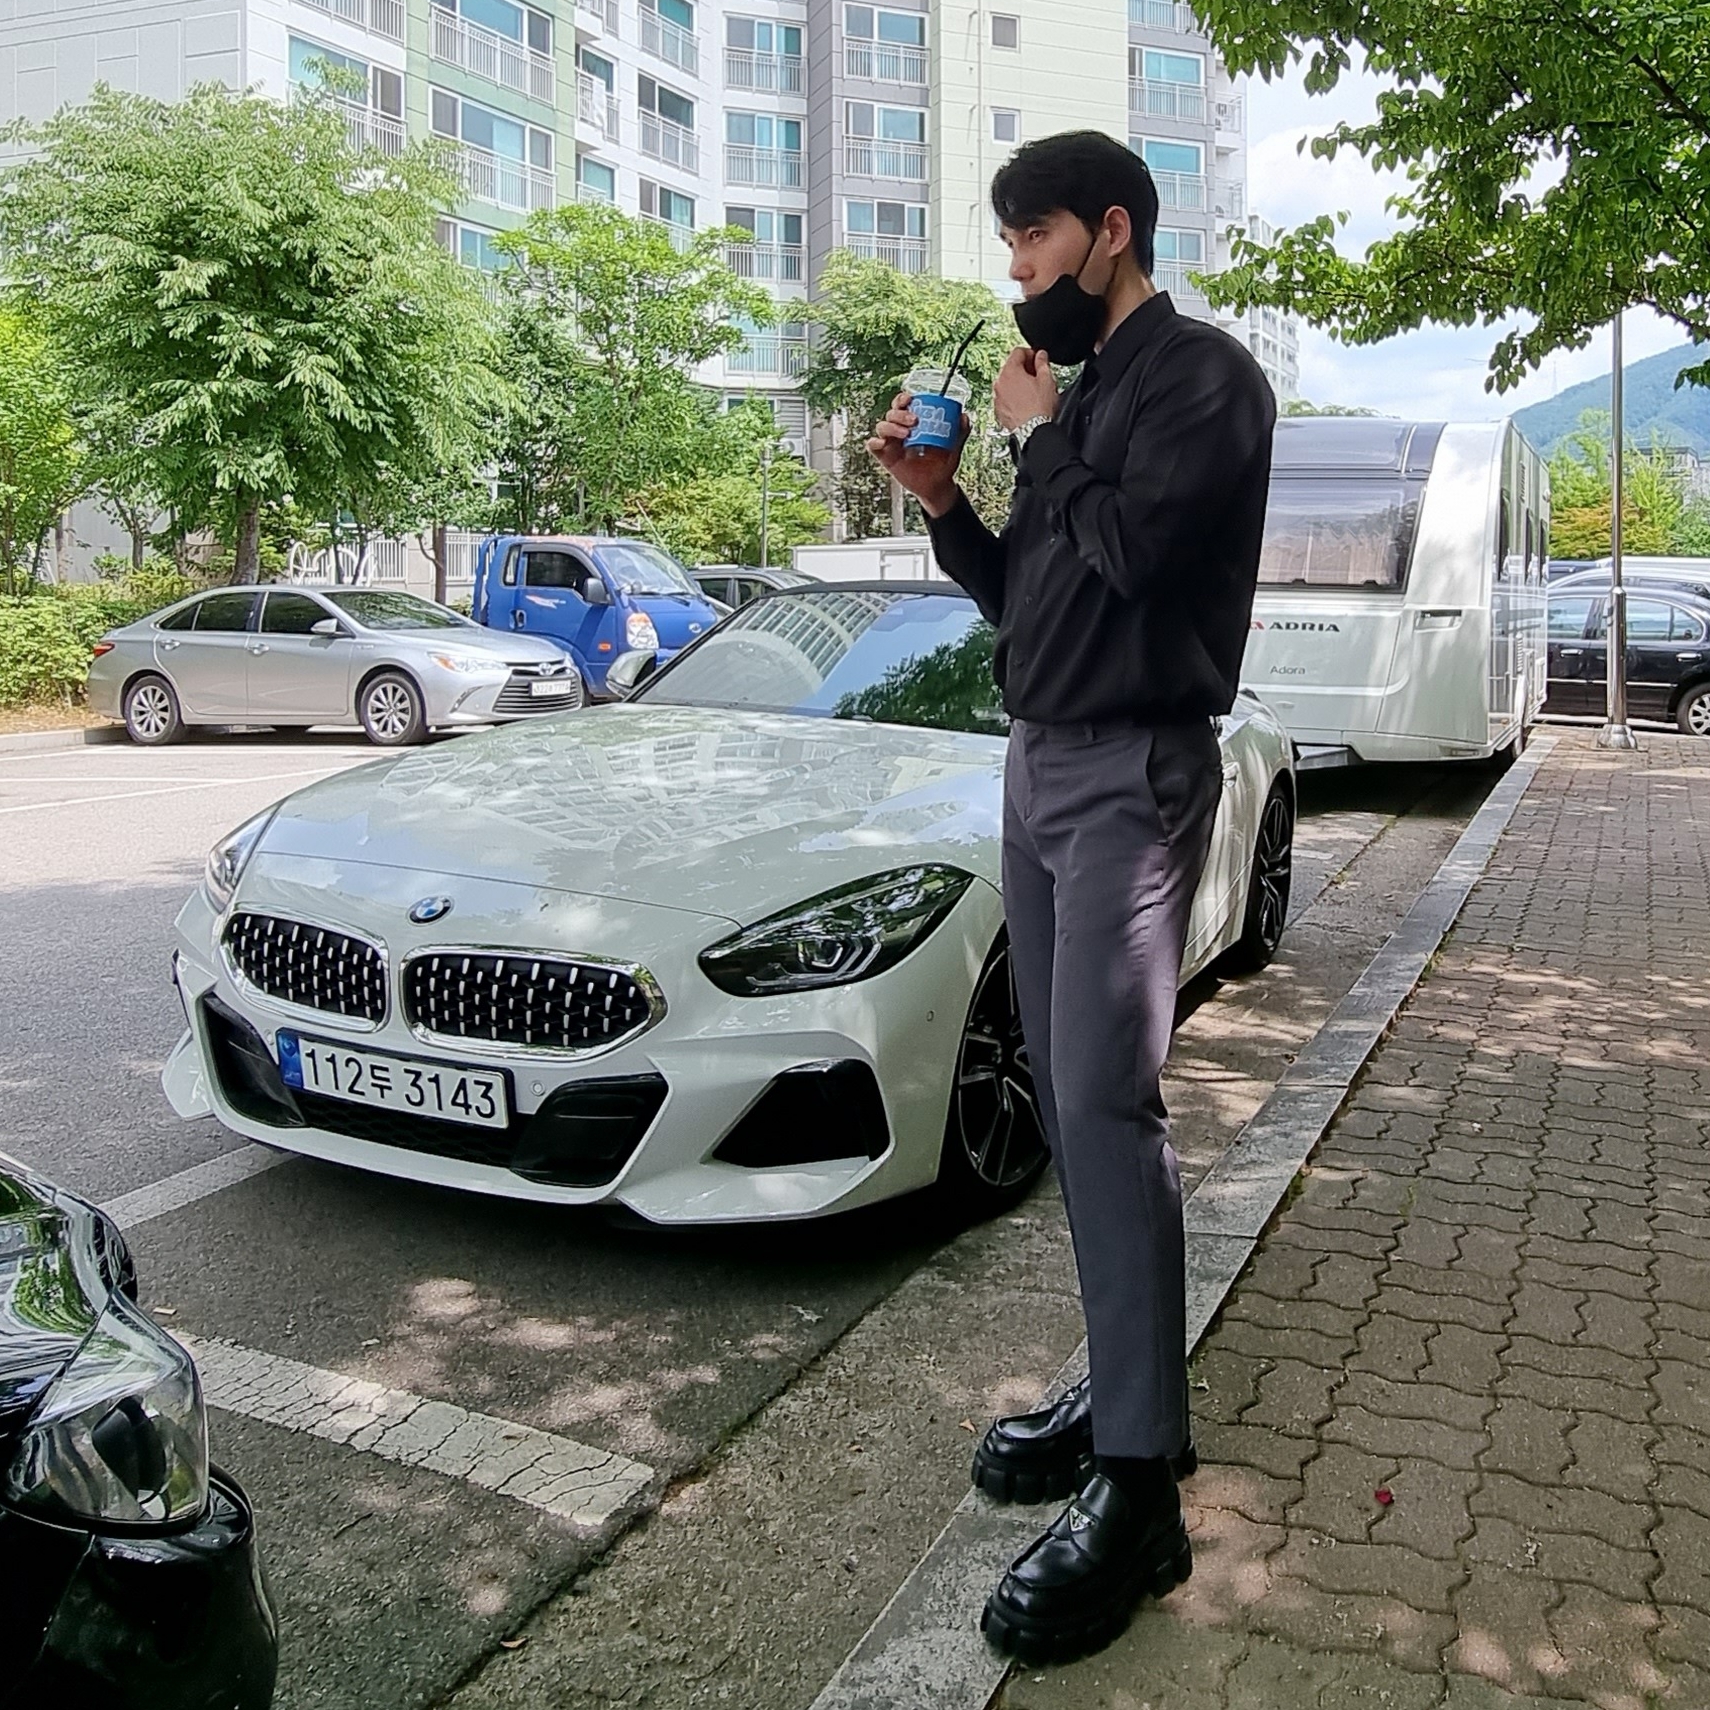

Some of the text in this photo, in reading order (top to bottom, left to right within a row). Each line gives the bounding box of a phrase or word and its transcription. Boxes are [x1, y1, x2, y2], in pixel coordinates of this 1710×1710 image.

[1269, 621, 1340, 632] ADRIA
[1270, 665, 1306, 675] Adora
[305, 1048, 496, 1118] 112두 3143
